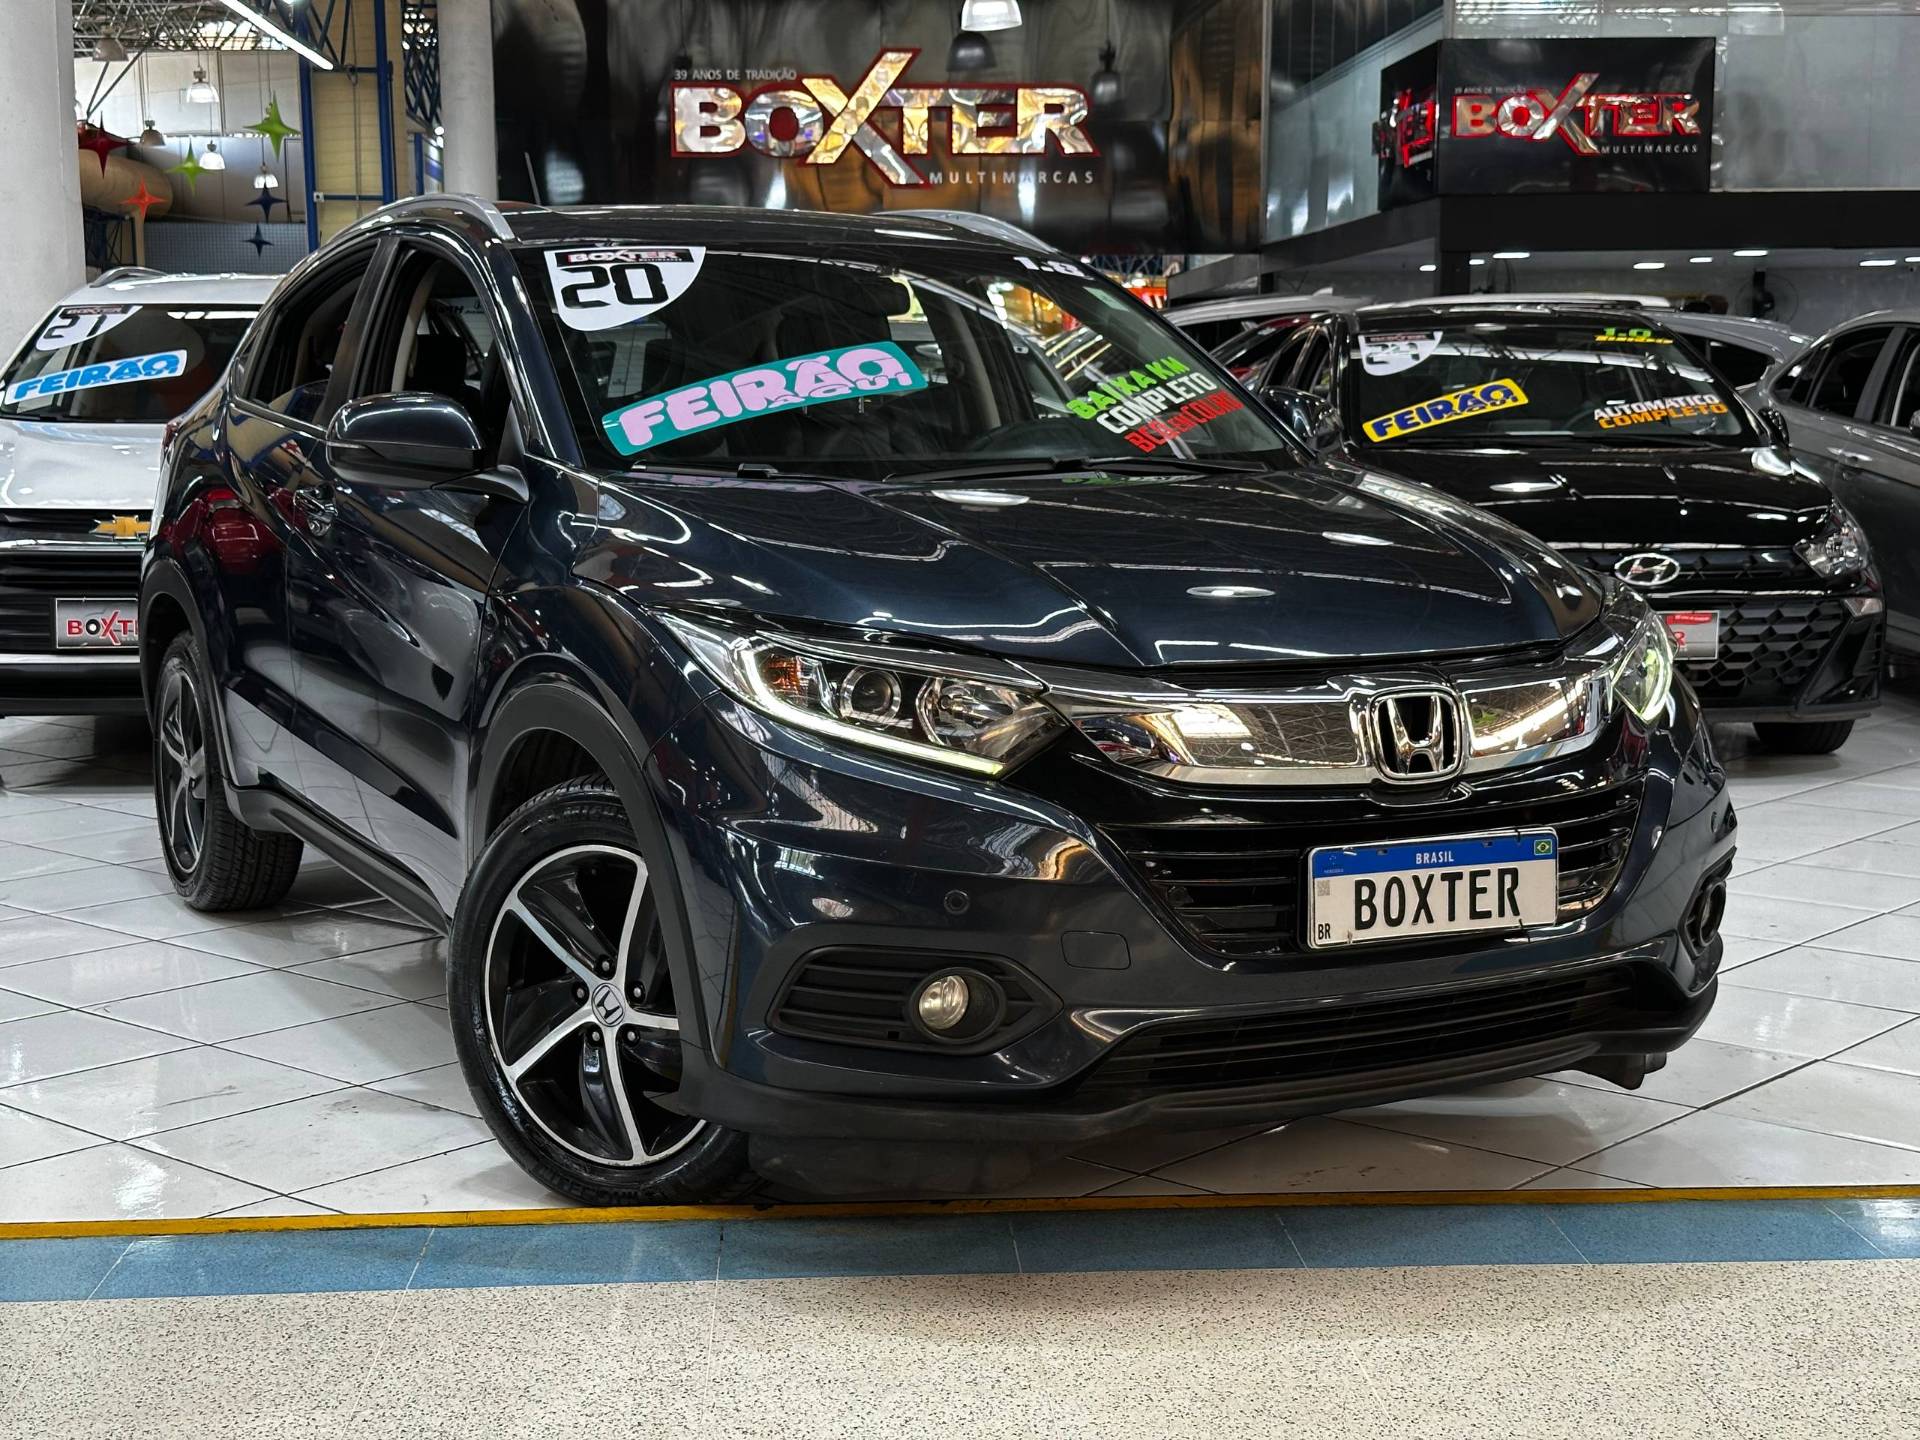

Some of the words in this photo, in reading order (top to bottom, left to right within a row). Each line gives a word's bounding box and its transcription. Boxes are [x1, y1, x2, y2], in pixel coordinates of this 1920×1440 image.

[674, 69, 688, 81] 39
[692, 69, 722, 81] ANOS
[726, 69, 741, 81] DE
[745, 67, 798, 82] TRADIÇÃO
[671, 47, 1099, 188] BOXTER
[1454, 73, 1701, 156] BOXTER
[1600, 143, 1698, 155] MULTIMARCAS
[929, 170, 1095, 185] MULTIMARCAS
[567, 249, 680, 264] BOXTER
[560, 264, 669, 309] 20
[1603, 327, 1652, 338] 1.0
[14, 353, 180, 400] FEIRÃO
[618, 348, 904, 447] FEIRÃO
[1066, 370, 1157, 420] BAIXA
[1097, 371, 1218, 434] COMPLETO
[1371, 384, 1515, 437] FEIRÃO
[1598, 403, 1729, 429] COMPLETO
[1415, 850, 1454, 865] BRASIL
[1354, 867, 1521, 931] BOXTER
[1317, 923, 1331, 940] BR
